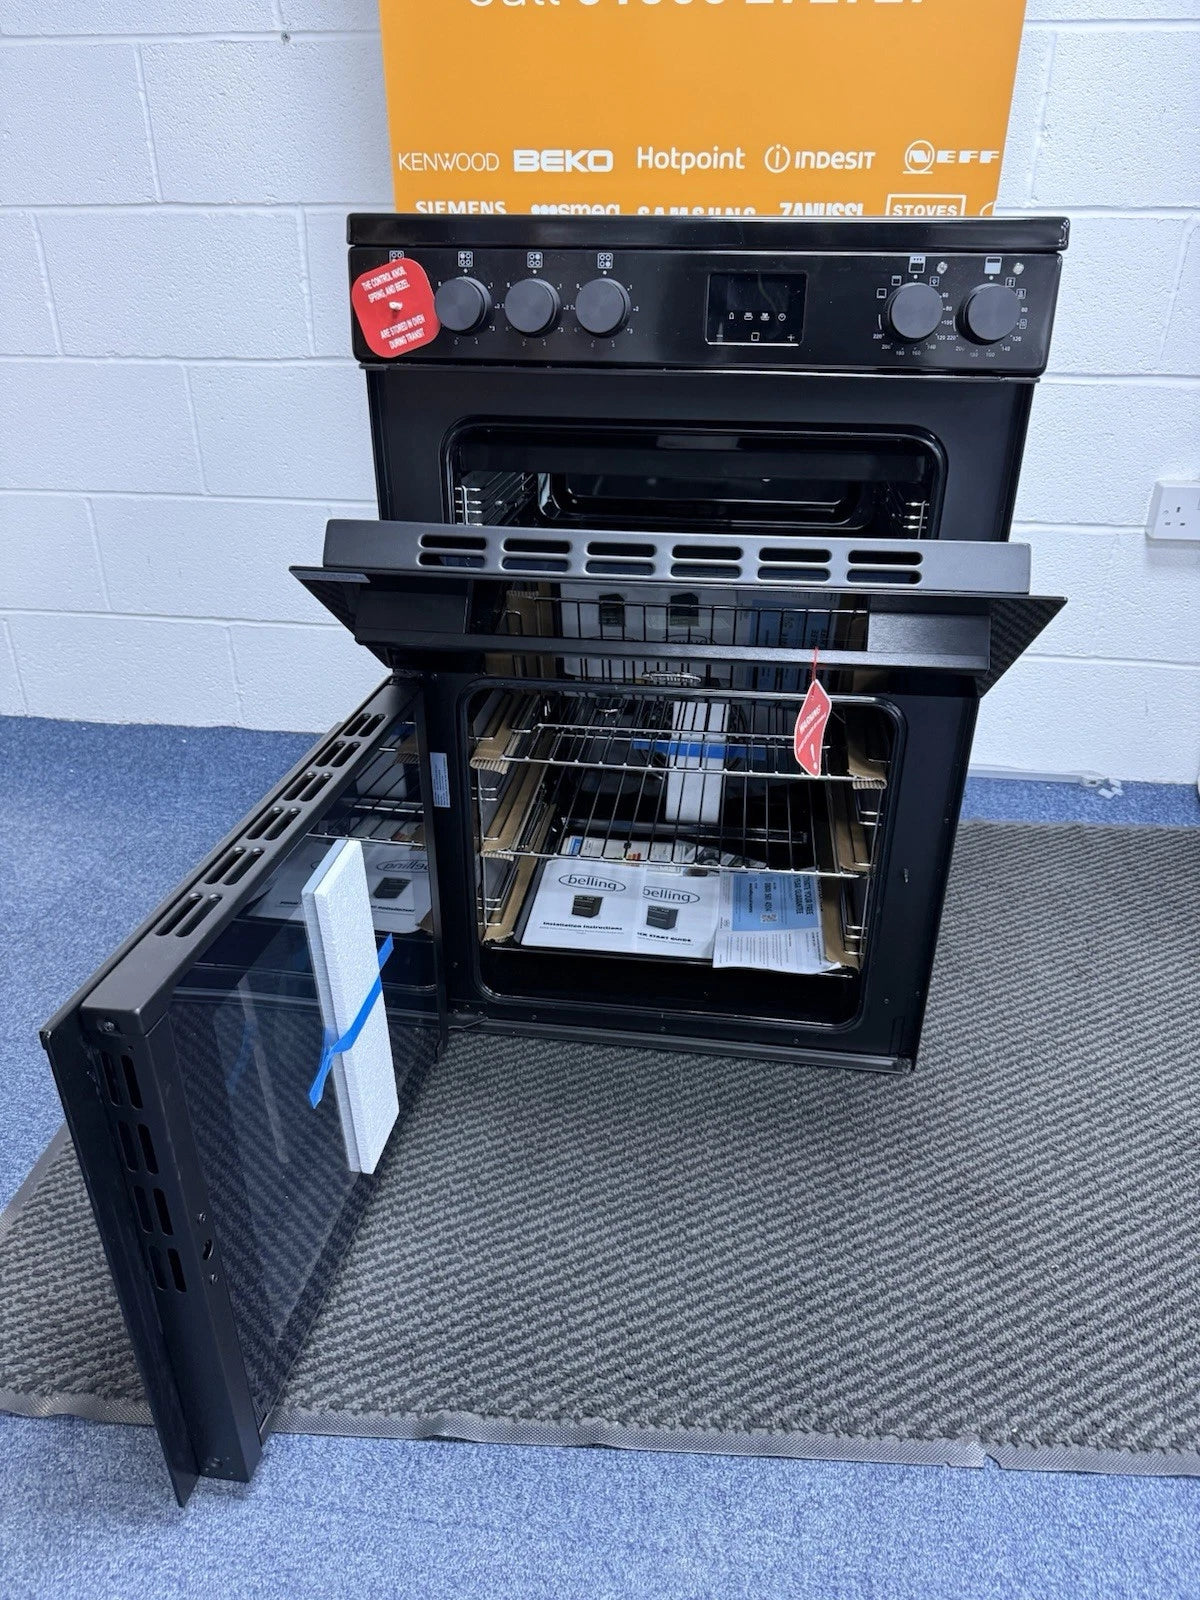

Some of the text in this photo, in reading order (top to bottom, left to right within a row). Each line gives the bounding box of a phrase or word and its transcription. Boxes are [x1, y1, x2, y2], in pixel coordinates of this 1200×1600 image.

[398, 152, 499, 173] KENWOOD
[513, 149, 614, 173] BEKO
[636, 146, 746, 175] Hotpoint
[904, 140, 1000, 174] NEFF
[415, 200, 507, 215] SIEMENS
[892, 203, 958, 216] STOVES
[371, 272, 393, 288] CONTROL
[568, 874, 618, 892] belling
[543, 921, 582, 929] Installation
